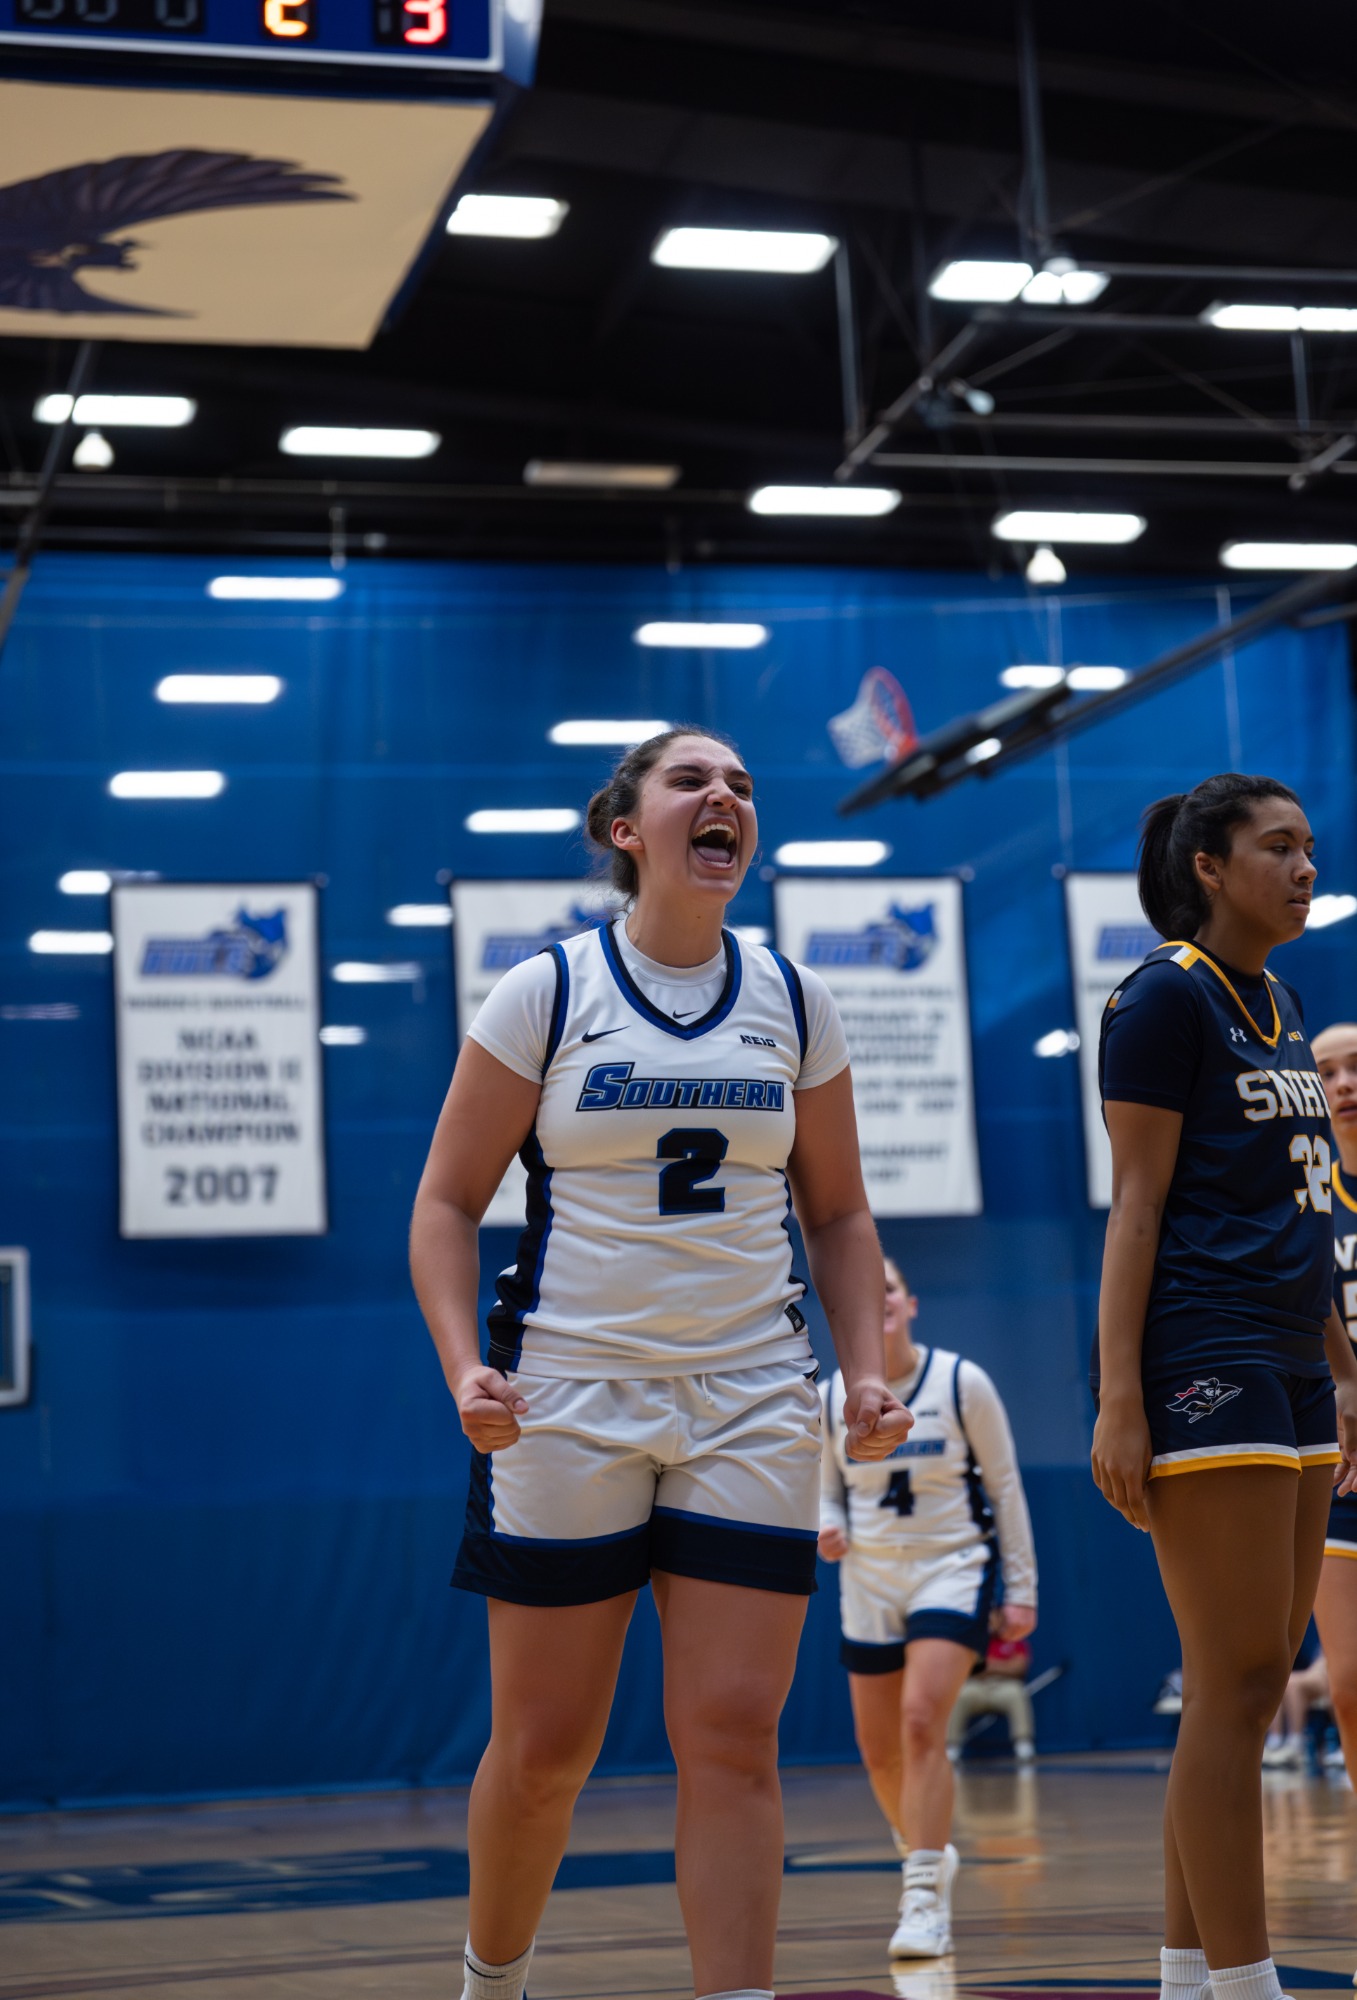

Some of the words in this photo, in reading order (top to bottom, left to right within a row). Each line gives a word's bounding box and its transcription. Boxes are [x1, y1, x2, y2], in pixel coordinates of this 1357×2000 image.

[178, 1028, 260, 1051] NCAA
[138, 1059, 271, 1082] DIVISION
[575, 1061, 785, 1112] SOUTHERN
[147, 1091, 290, 1114] NATIONAL
[140, 1122, 300, 1146] CHAMPION
[164, 1166, 280, 1207] 2007
[656, 1127, 729, 1216] 2
[879, 1469, 915, 1517] 4
